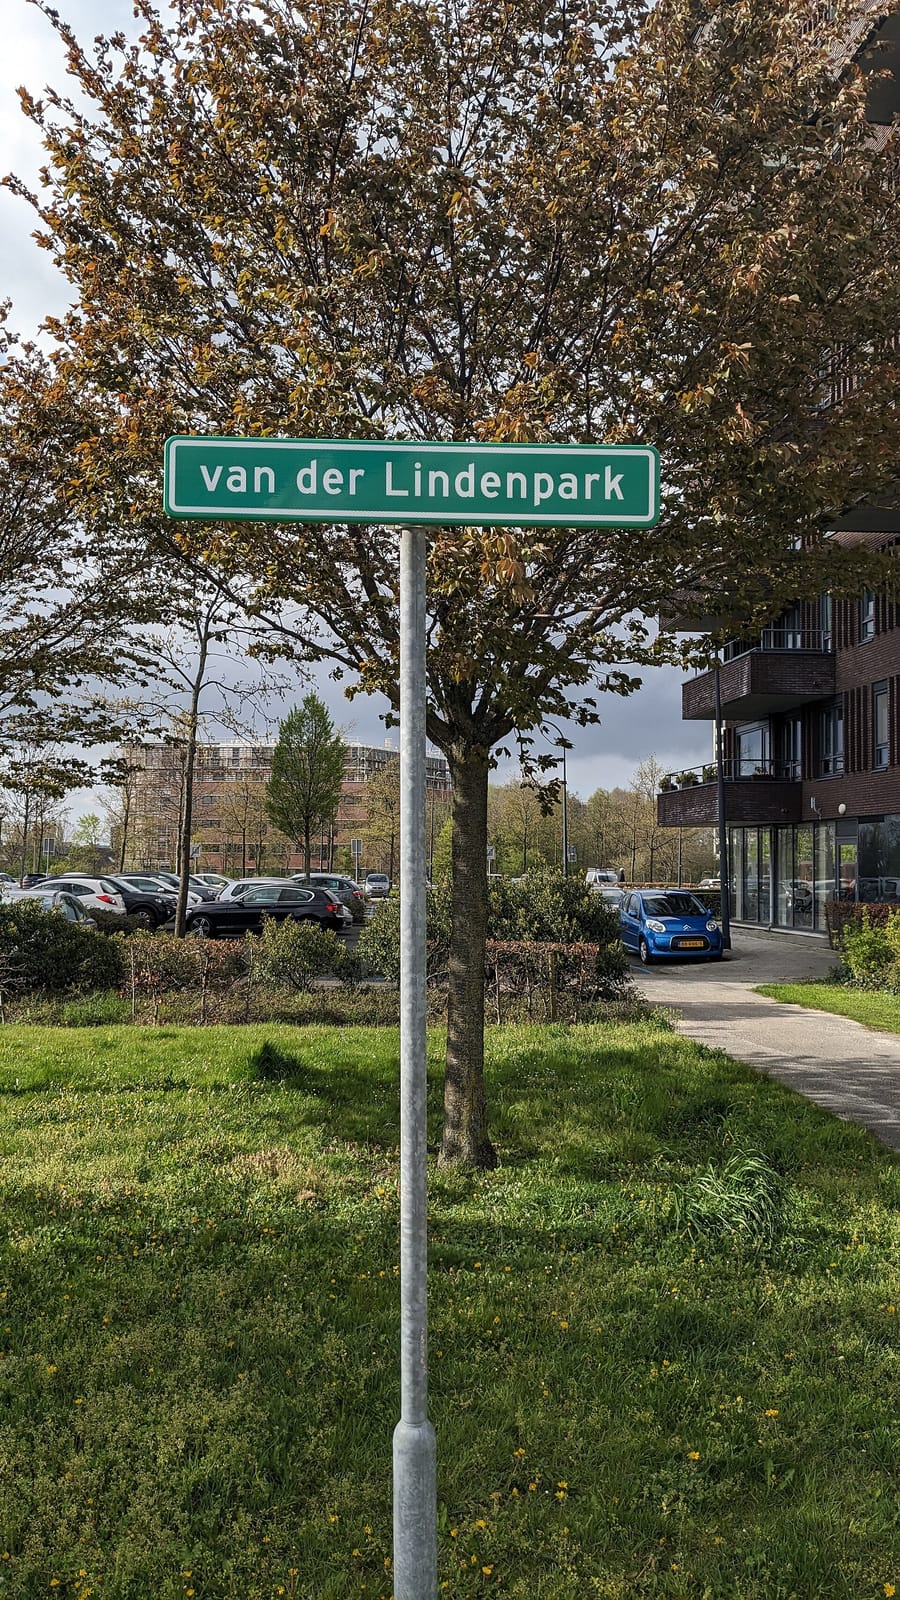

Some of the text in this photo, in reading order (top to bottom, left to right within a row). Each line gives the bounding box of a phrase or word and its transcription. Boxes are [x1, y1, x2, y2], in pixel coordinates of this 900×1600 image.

[199, 459, 625, 507] van der Lindenpark
